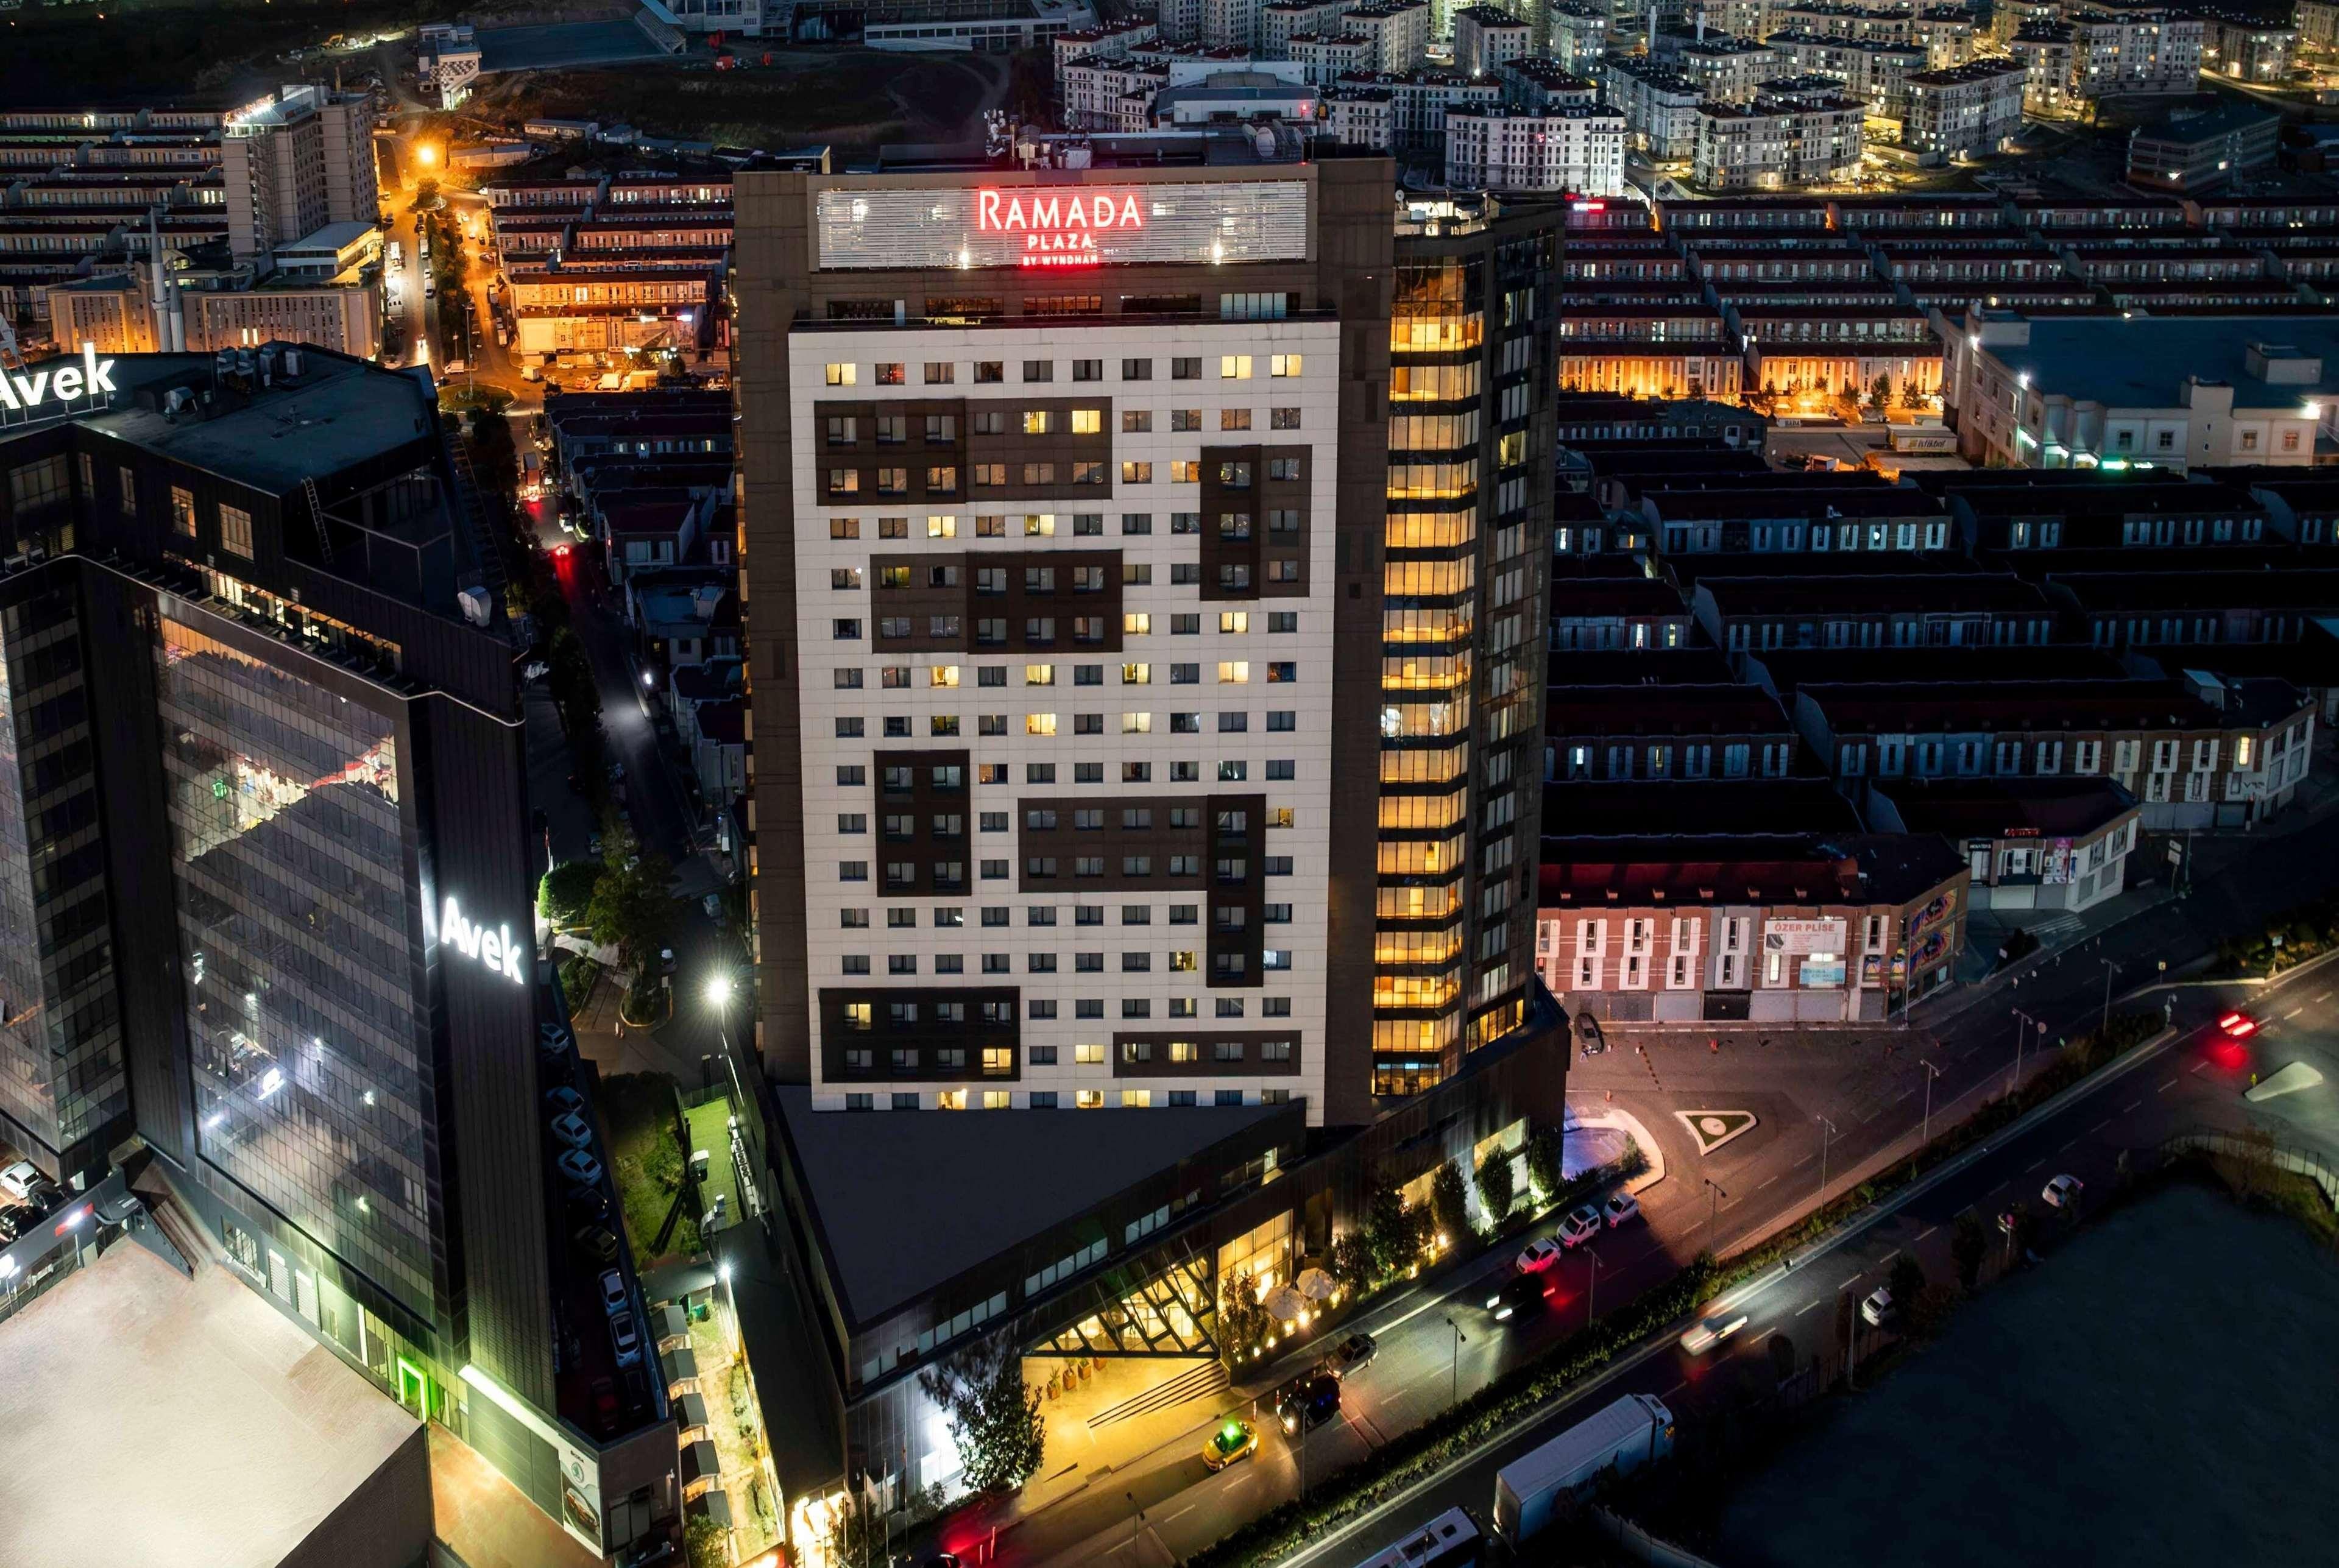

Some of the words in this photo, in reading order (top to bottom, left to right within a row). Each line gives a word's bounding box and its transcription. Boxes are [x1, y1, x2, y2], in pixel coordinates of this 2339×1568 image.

[979, 189, 1142, 231] RAMADA
[1027, 233, 1093, 250] PLAZA
[1023, 256, 1037, 266] BY
[1042, 254, 1099, 266] WYNDHAM
[1774, 922, 1803, 932] ÖZER
[441, 896, 524, 985] Avek
